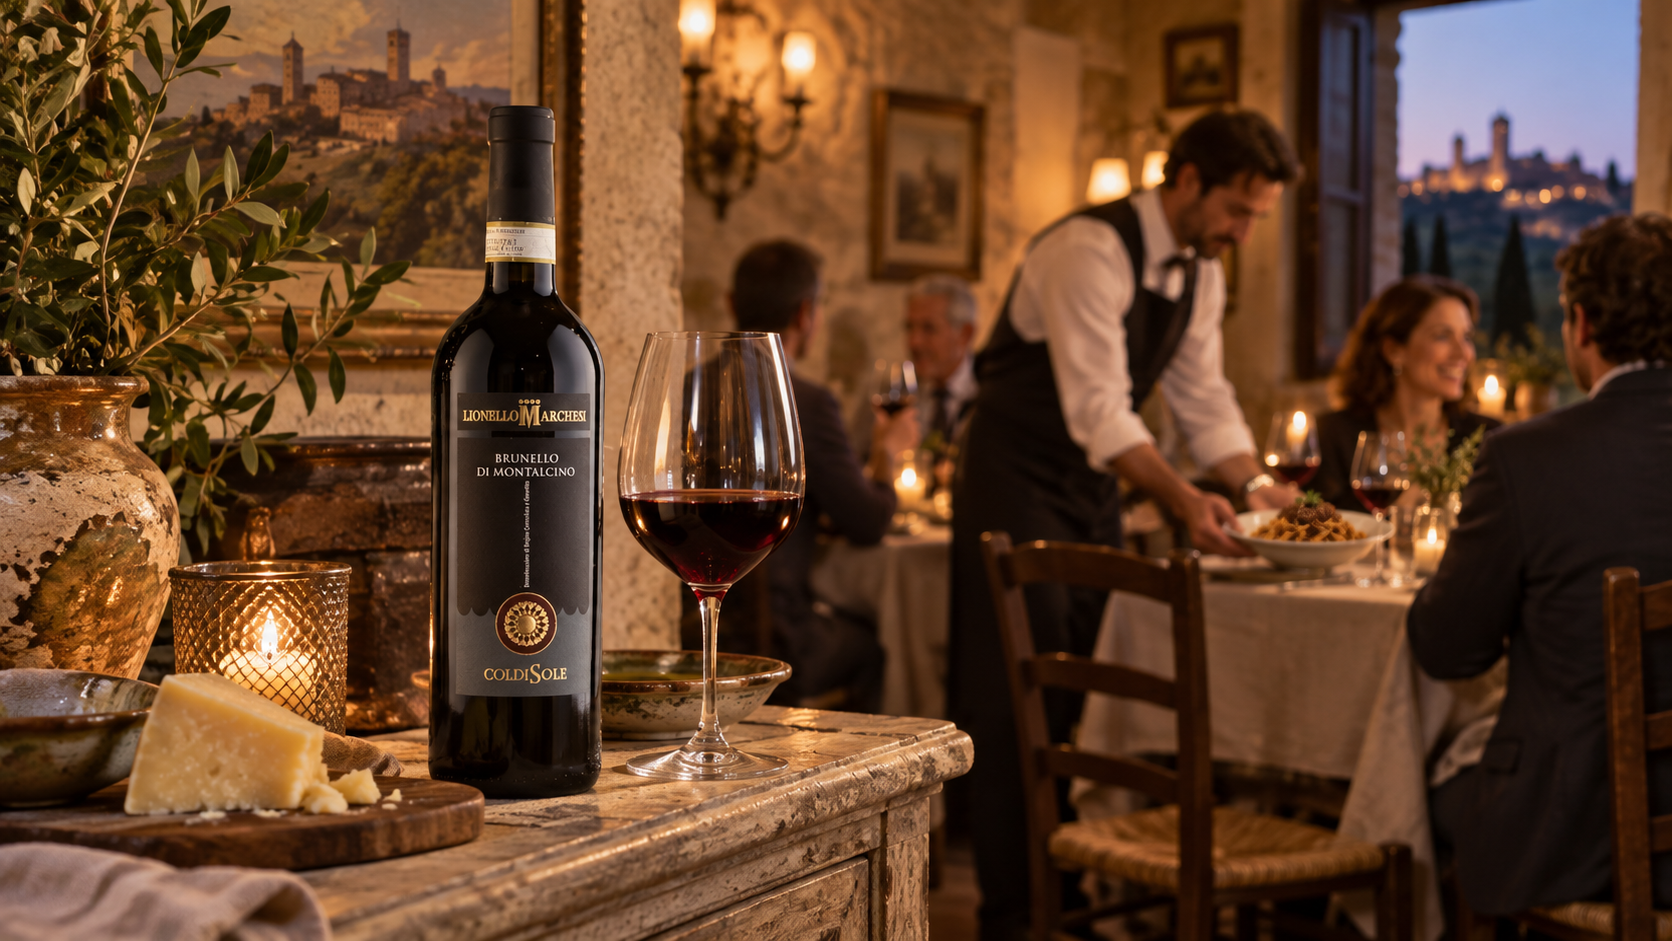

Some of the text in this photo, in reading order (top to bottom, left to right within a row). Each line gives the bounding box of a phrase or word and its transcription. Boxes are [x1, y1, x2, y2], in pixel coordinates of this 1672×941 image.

[463, 405, 586, 428] LIONELLO MARCHESI
[495, 453, 559, 464] BRUNELLO
[476, 467, 576, 477] DI MONTALCINO
